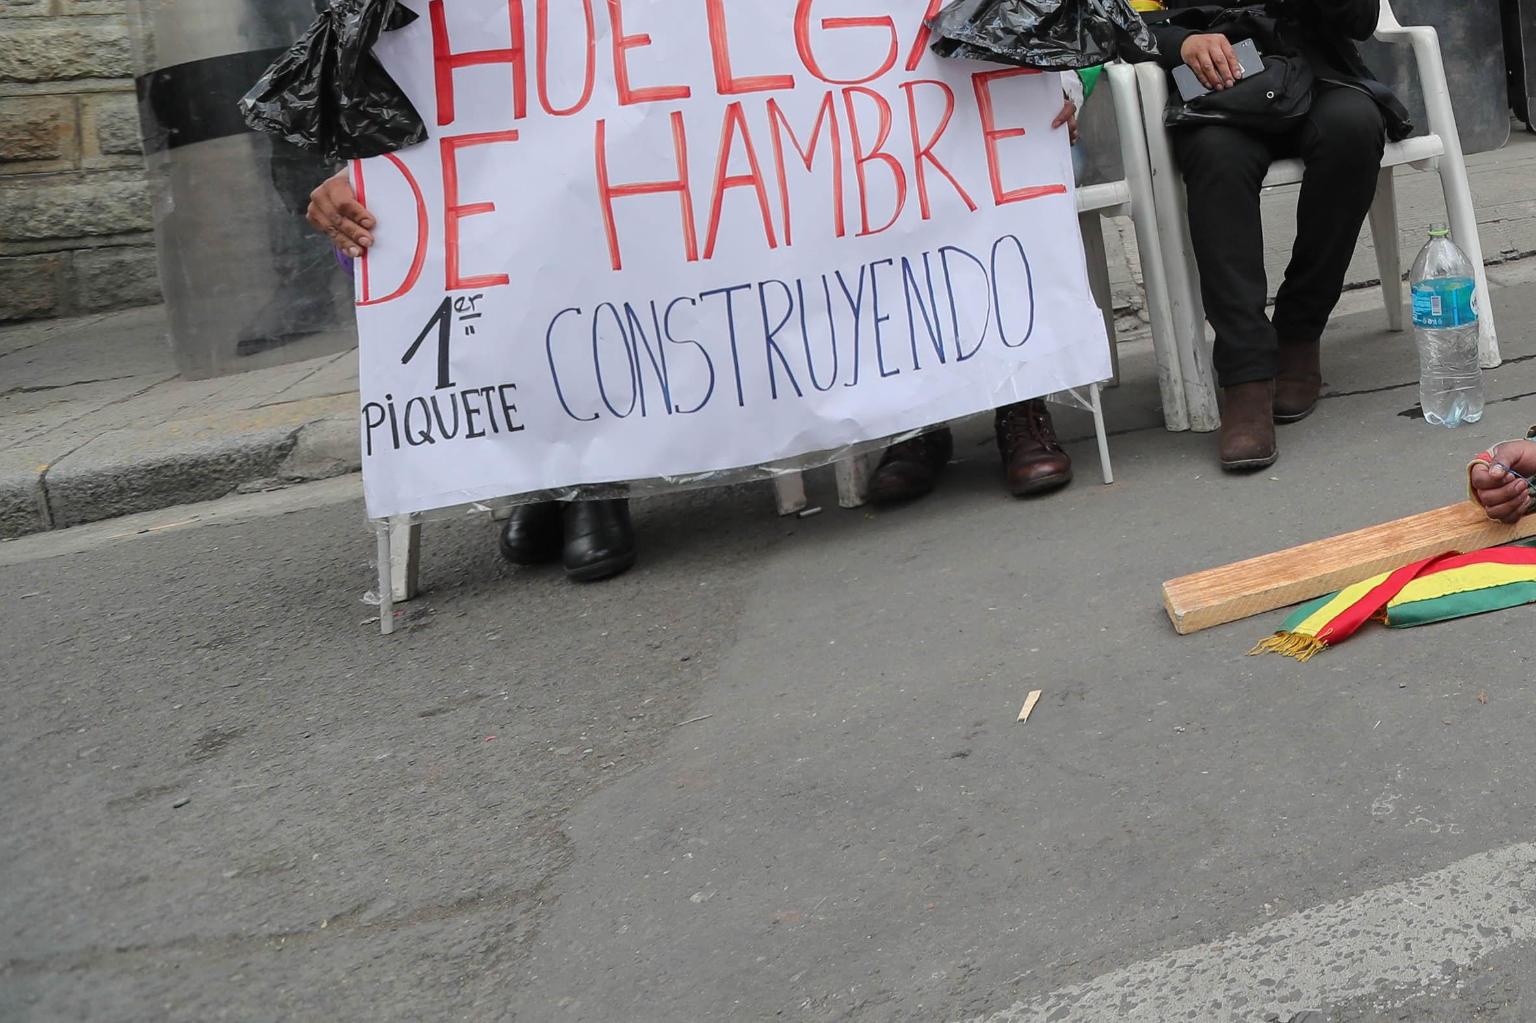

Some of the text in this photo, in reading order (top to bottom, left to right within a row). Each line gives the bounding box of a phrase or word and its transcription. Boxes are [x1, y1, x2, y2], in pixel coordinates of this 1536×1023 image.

[350, 67, 1068, 306] DE HAMBRE
[545, 234, 1034, 424] CONSTRUYENDO
